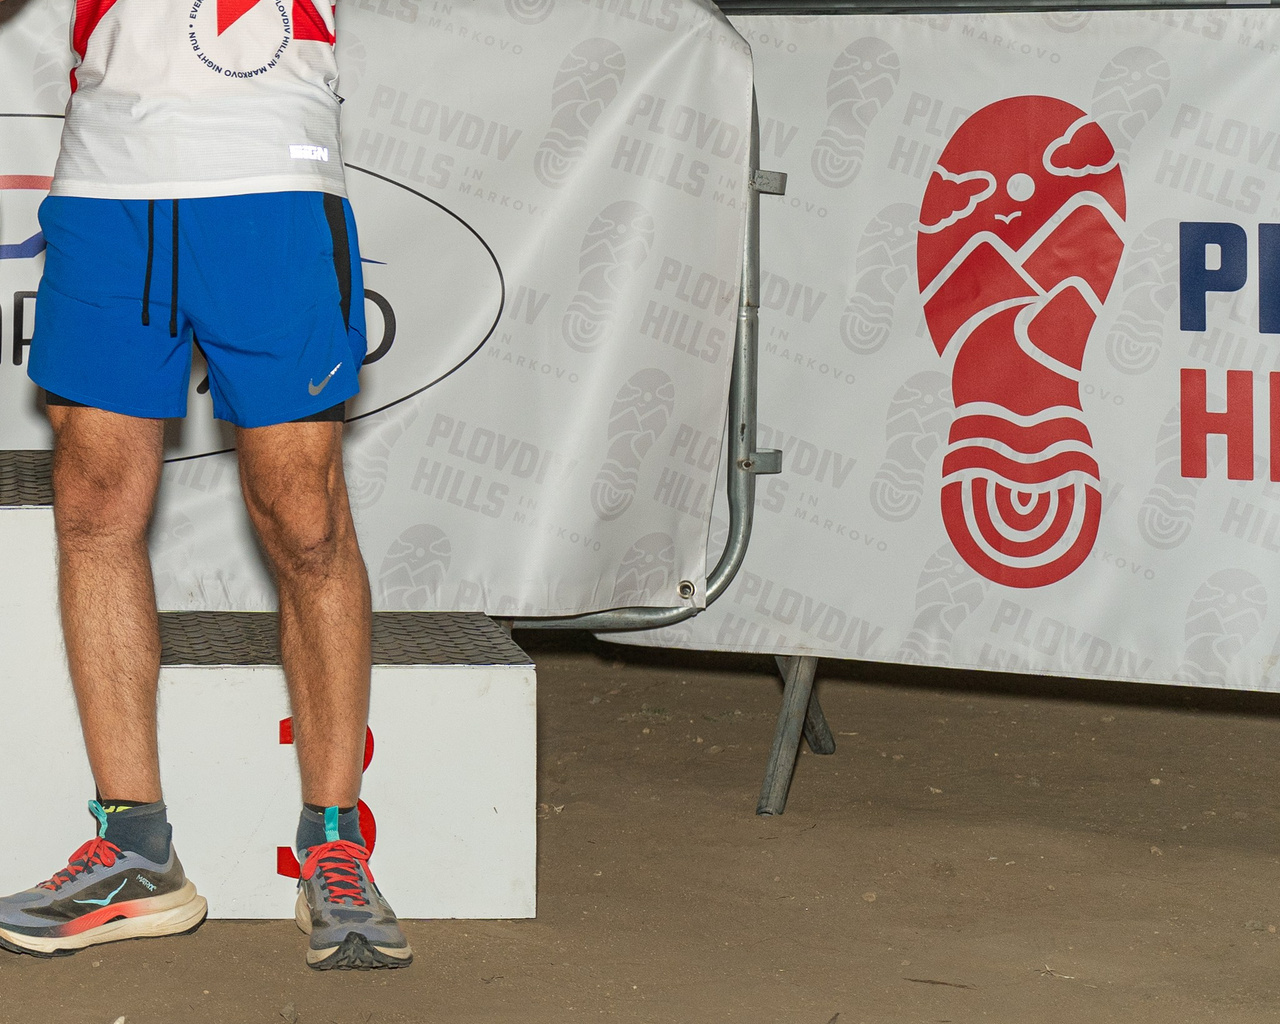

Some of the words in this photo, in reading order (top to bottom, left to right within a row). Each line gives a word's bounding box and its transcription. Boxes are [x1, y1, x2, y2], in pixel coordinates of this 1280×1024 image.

[432, 1, 454, 15] IN
[188, 32, 200, 52] RUN
[274, 36, 290, 59] HILLS
[428, 16, 525, 55] MARKOVO
[961, 24, 1062, 65] MARKOVO
[196, 52, 223, 74] NIGHT
[224, 66, 267, 78] MARKOVO
[267, 59, 277, 68] IN
[368, 83, 523, 162] PLOVDIV
[353, 127, 455, 191] HILLS
[463, 165, 484, 182] IN
[611, 132, 710, 198] HILLS
[718, 174, 738, 191] IN
[1154, 148, 1266, 215] HILLS
[493, 330, 512, 346] IN
[640, 300, 726, 365] HILLS
[487, 345, 580, 384] MARKOVO
[765, 342, 856, 386] MARKOVO
[410, 456, 510, 520] HILLS
[519, 495, 537, 511] IN
[799, 492, 819, 507] IN
[794, 507, 888, 553] MARKOVO
[733, 570, 884, 657] PLOVDIV
